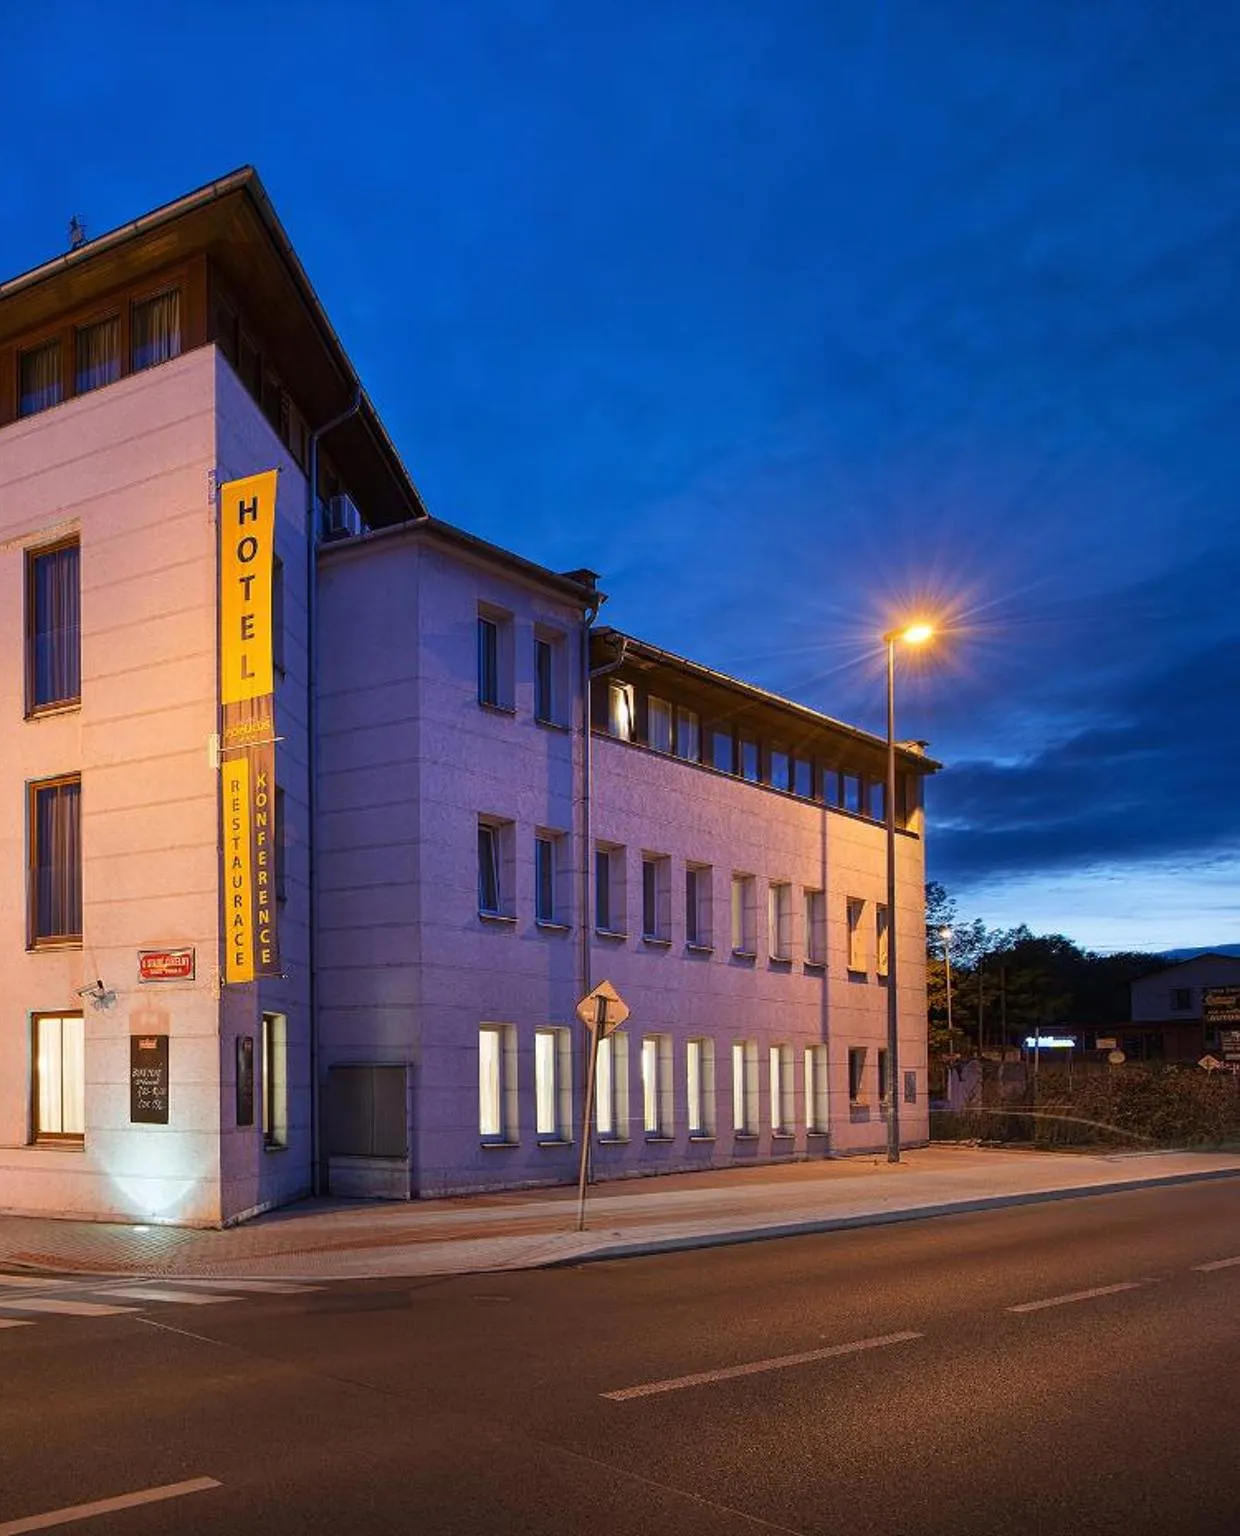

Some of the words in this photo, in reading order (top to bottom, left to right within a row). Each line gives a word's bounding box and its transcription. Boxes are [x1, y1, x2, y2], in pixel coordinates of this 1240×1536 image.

[236, 496, 259, 680] HOTEL
[230, 779, 245, 966] RESTAURACE
[256, 774, 271, 964] KONFERENCE
